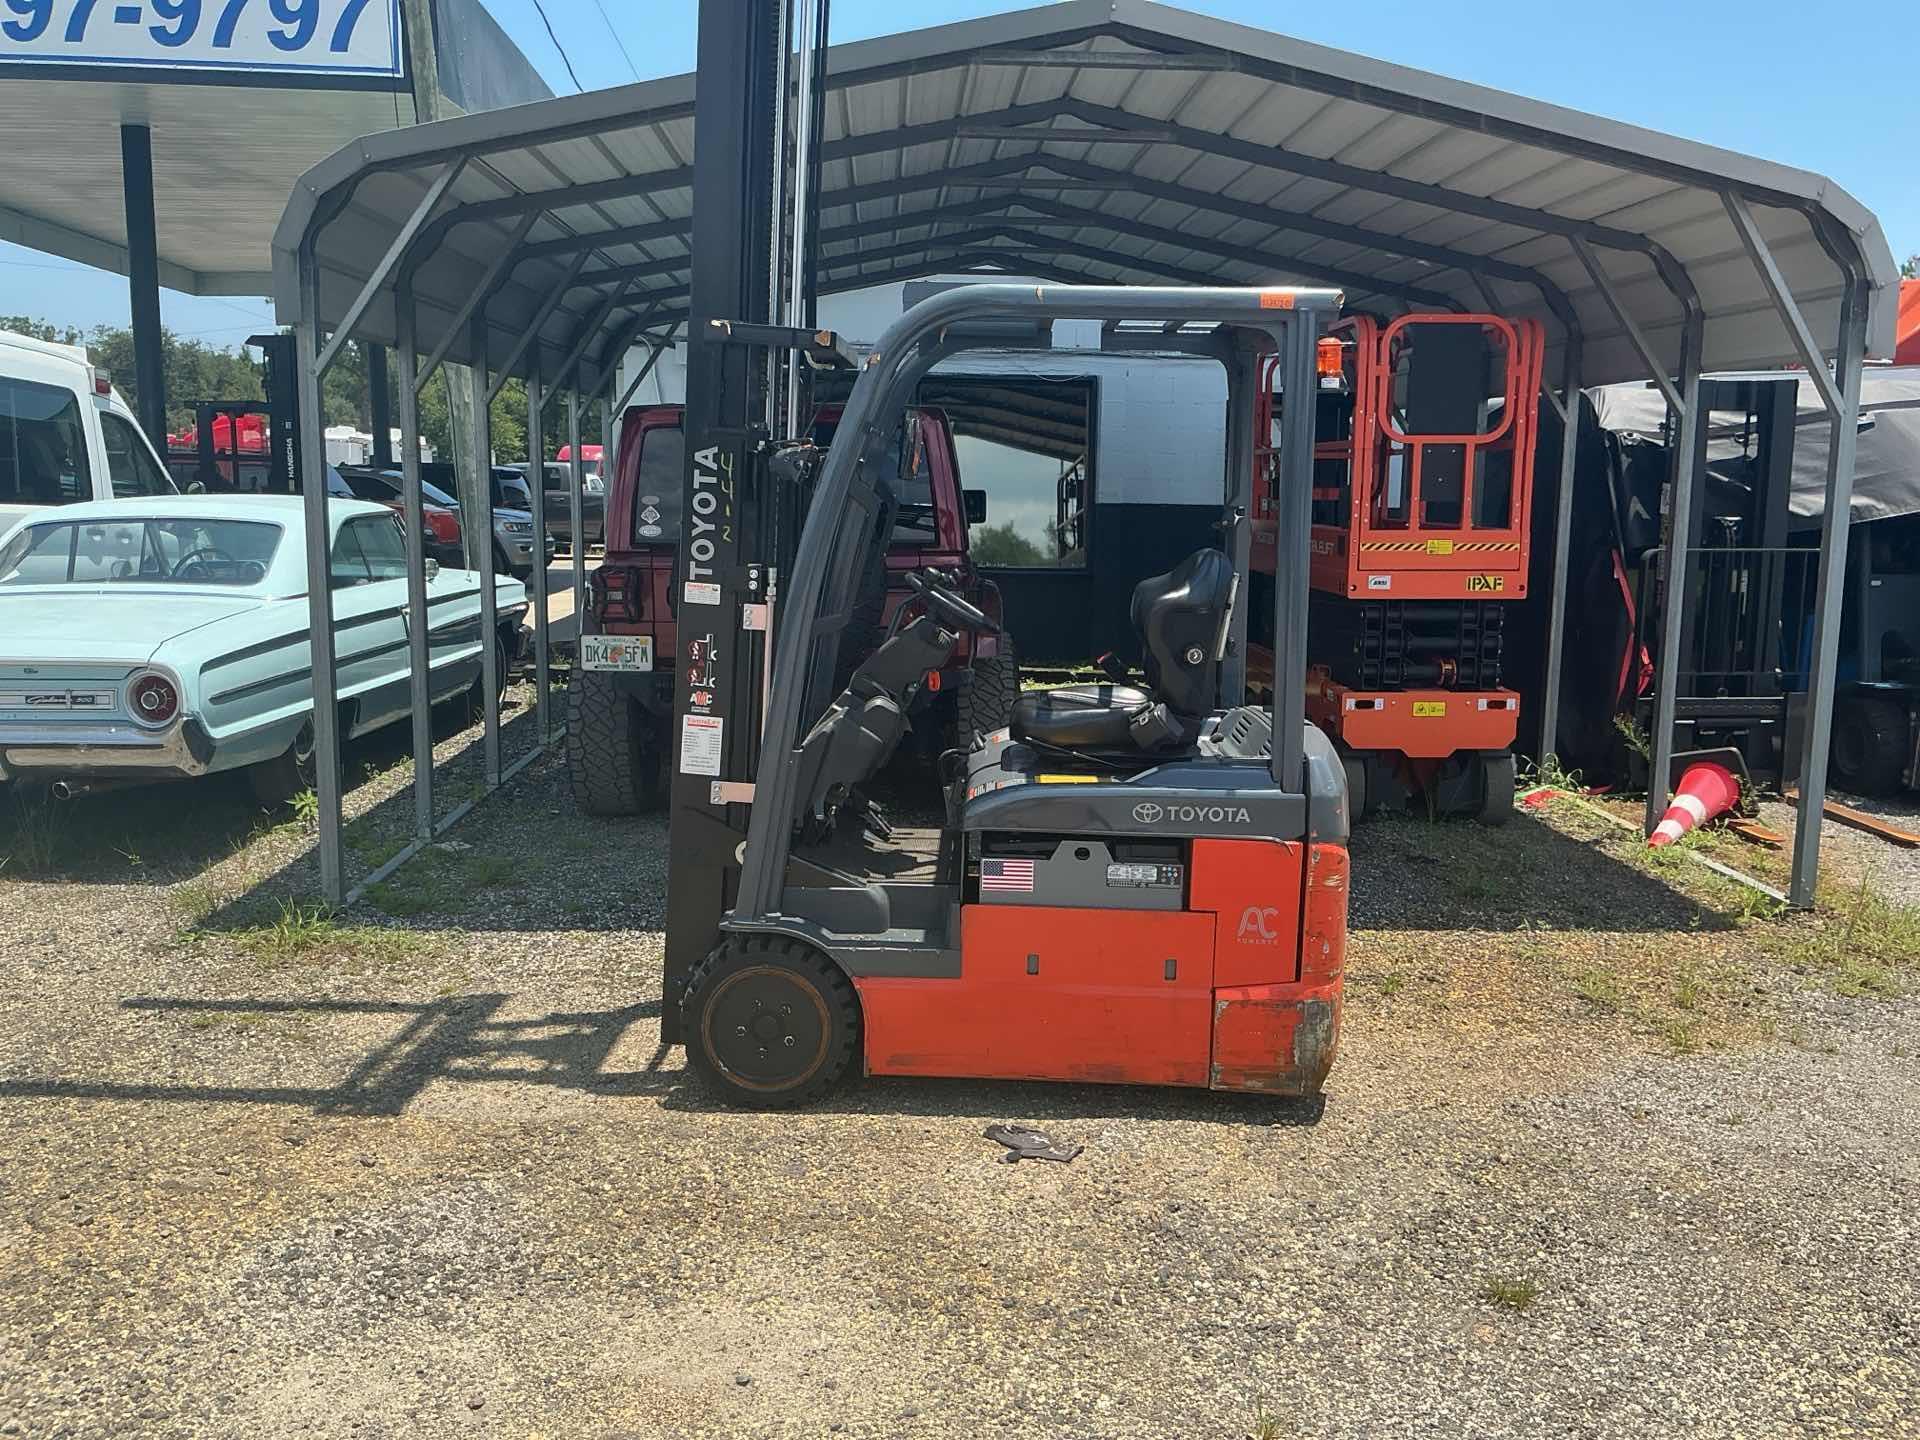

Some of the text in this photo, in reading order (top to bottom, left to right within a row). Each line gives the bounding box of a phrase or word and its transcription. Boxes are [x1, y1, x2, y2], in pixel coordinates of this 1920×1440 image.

[689, 446, 719, 581] TOYOTA
[1467, 573, 1503, 591] IPAF
[1167, 806, 1251, 822] TOYOTA
